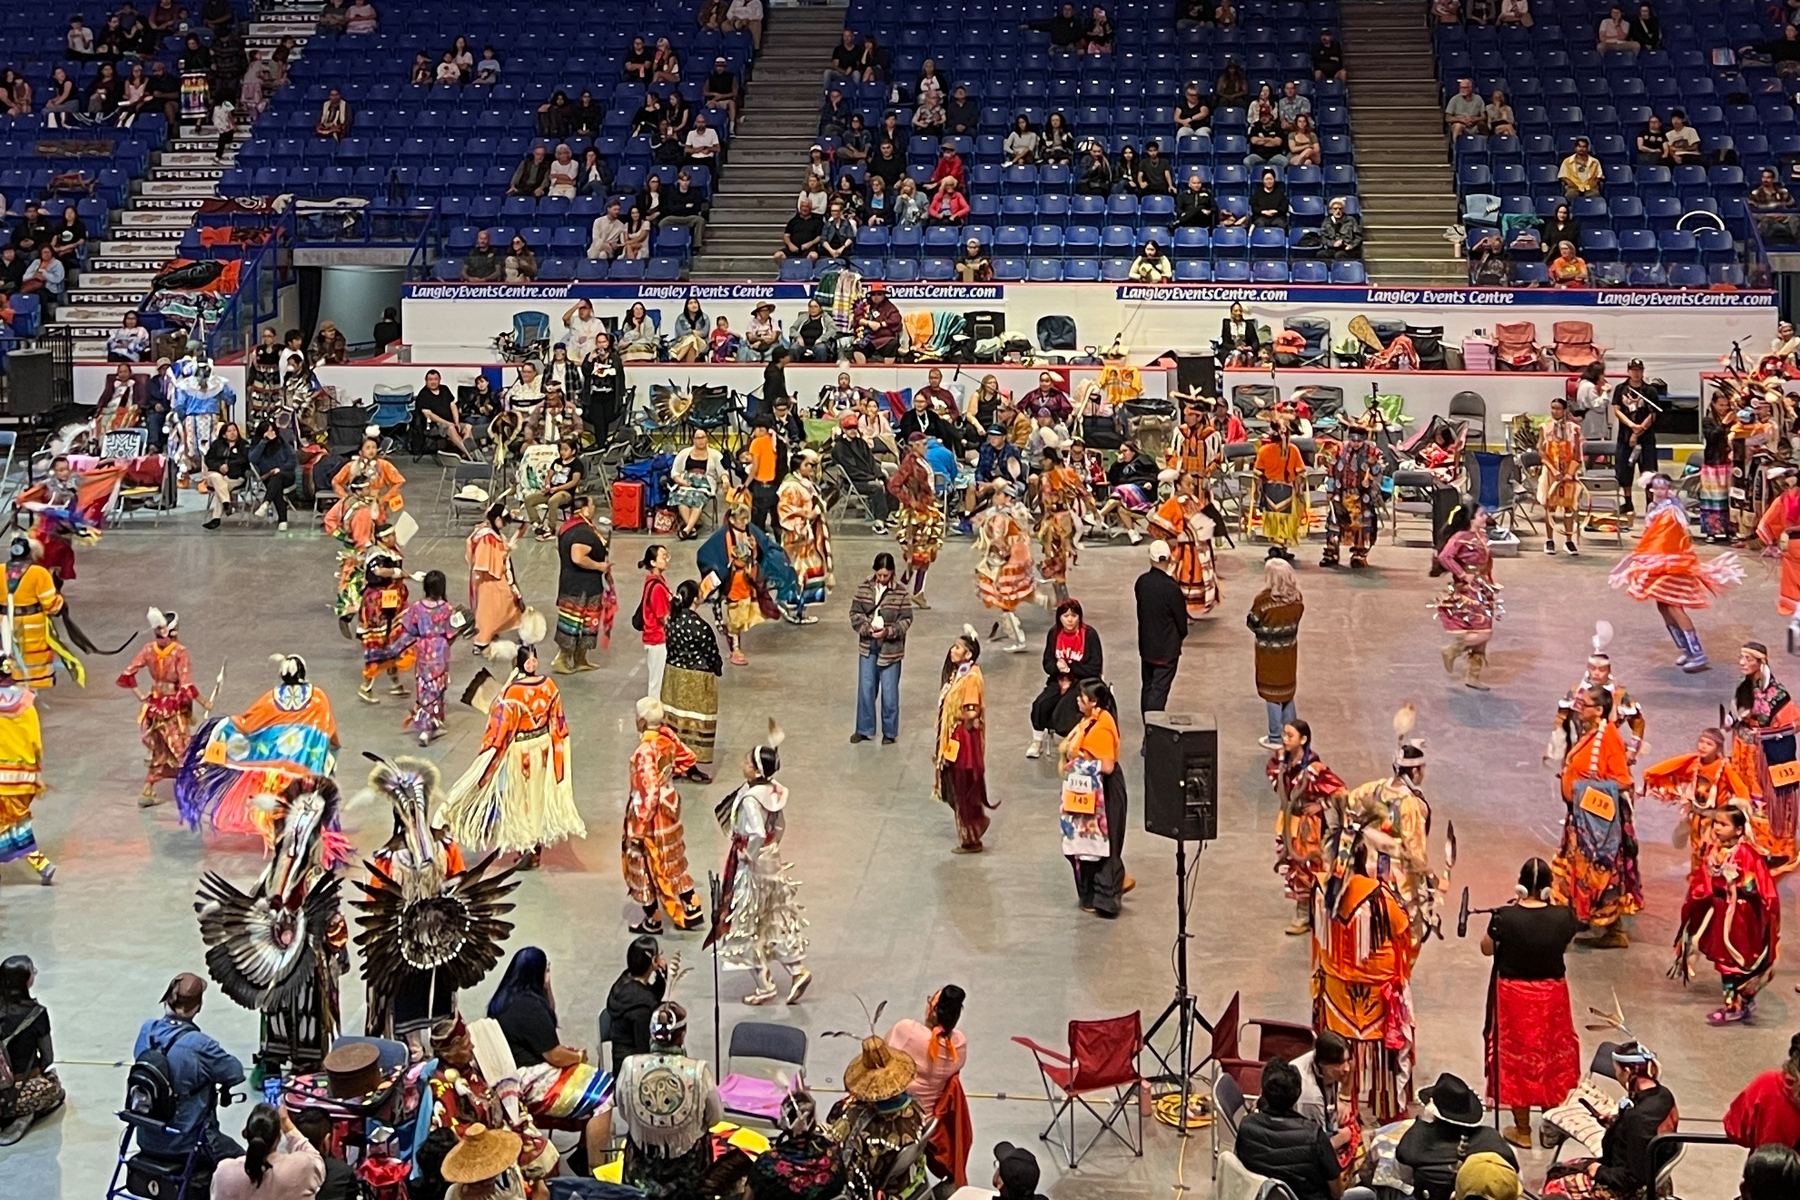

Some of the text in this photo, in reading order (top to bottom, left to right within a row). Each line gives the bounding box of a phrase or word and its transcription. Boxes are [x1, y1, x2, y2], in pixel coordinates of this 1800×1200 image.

[260, 14, 320, 22] PRESTO
[156, 170, 224, 178] PRESTO
[135, 200, 204, 208] PRESTO
[114, 230, 185, 238] PRESTO
[94, 261, 164, 269] PRESTO
[411, 285, 568, 299] LangleyEventsCentre.com
[638, 285, 774, 299] Langley Events Centre
[1122, 286, 1288, 301] LangleyEventsCentre.com
[1366, 289, 1514, 304] Langley Events Centre
[71, 294, 143, 303] PRESTO
[1597, 291, 1773, 307] LangleyEventsCentre.com
[1592, 796, 1609, 810] 138
